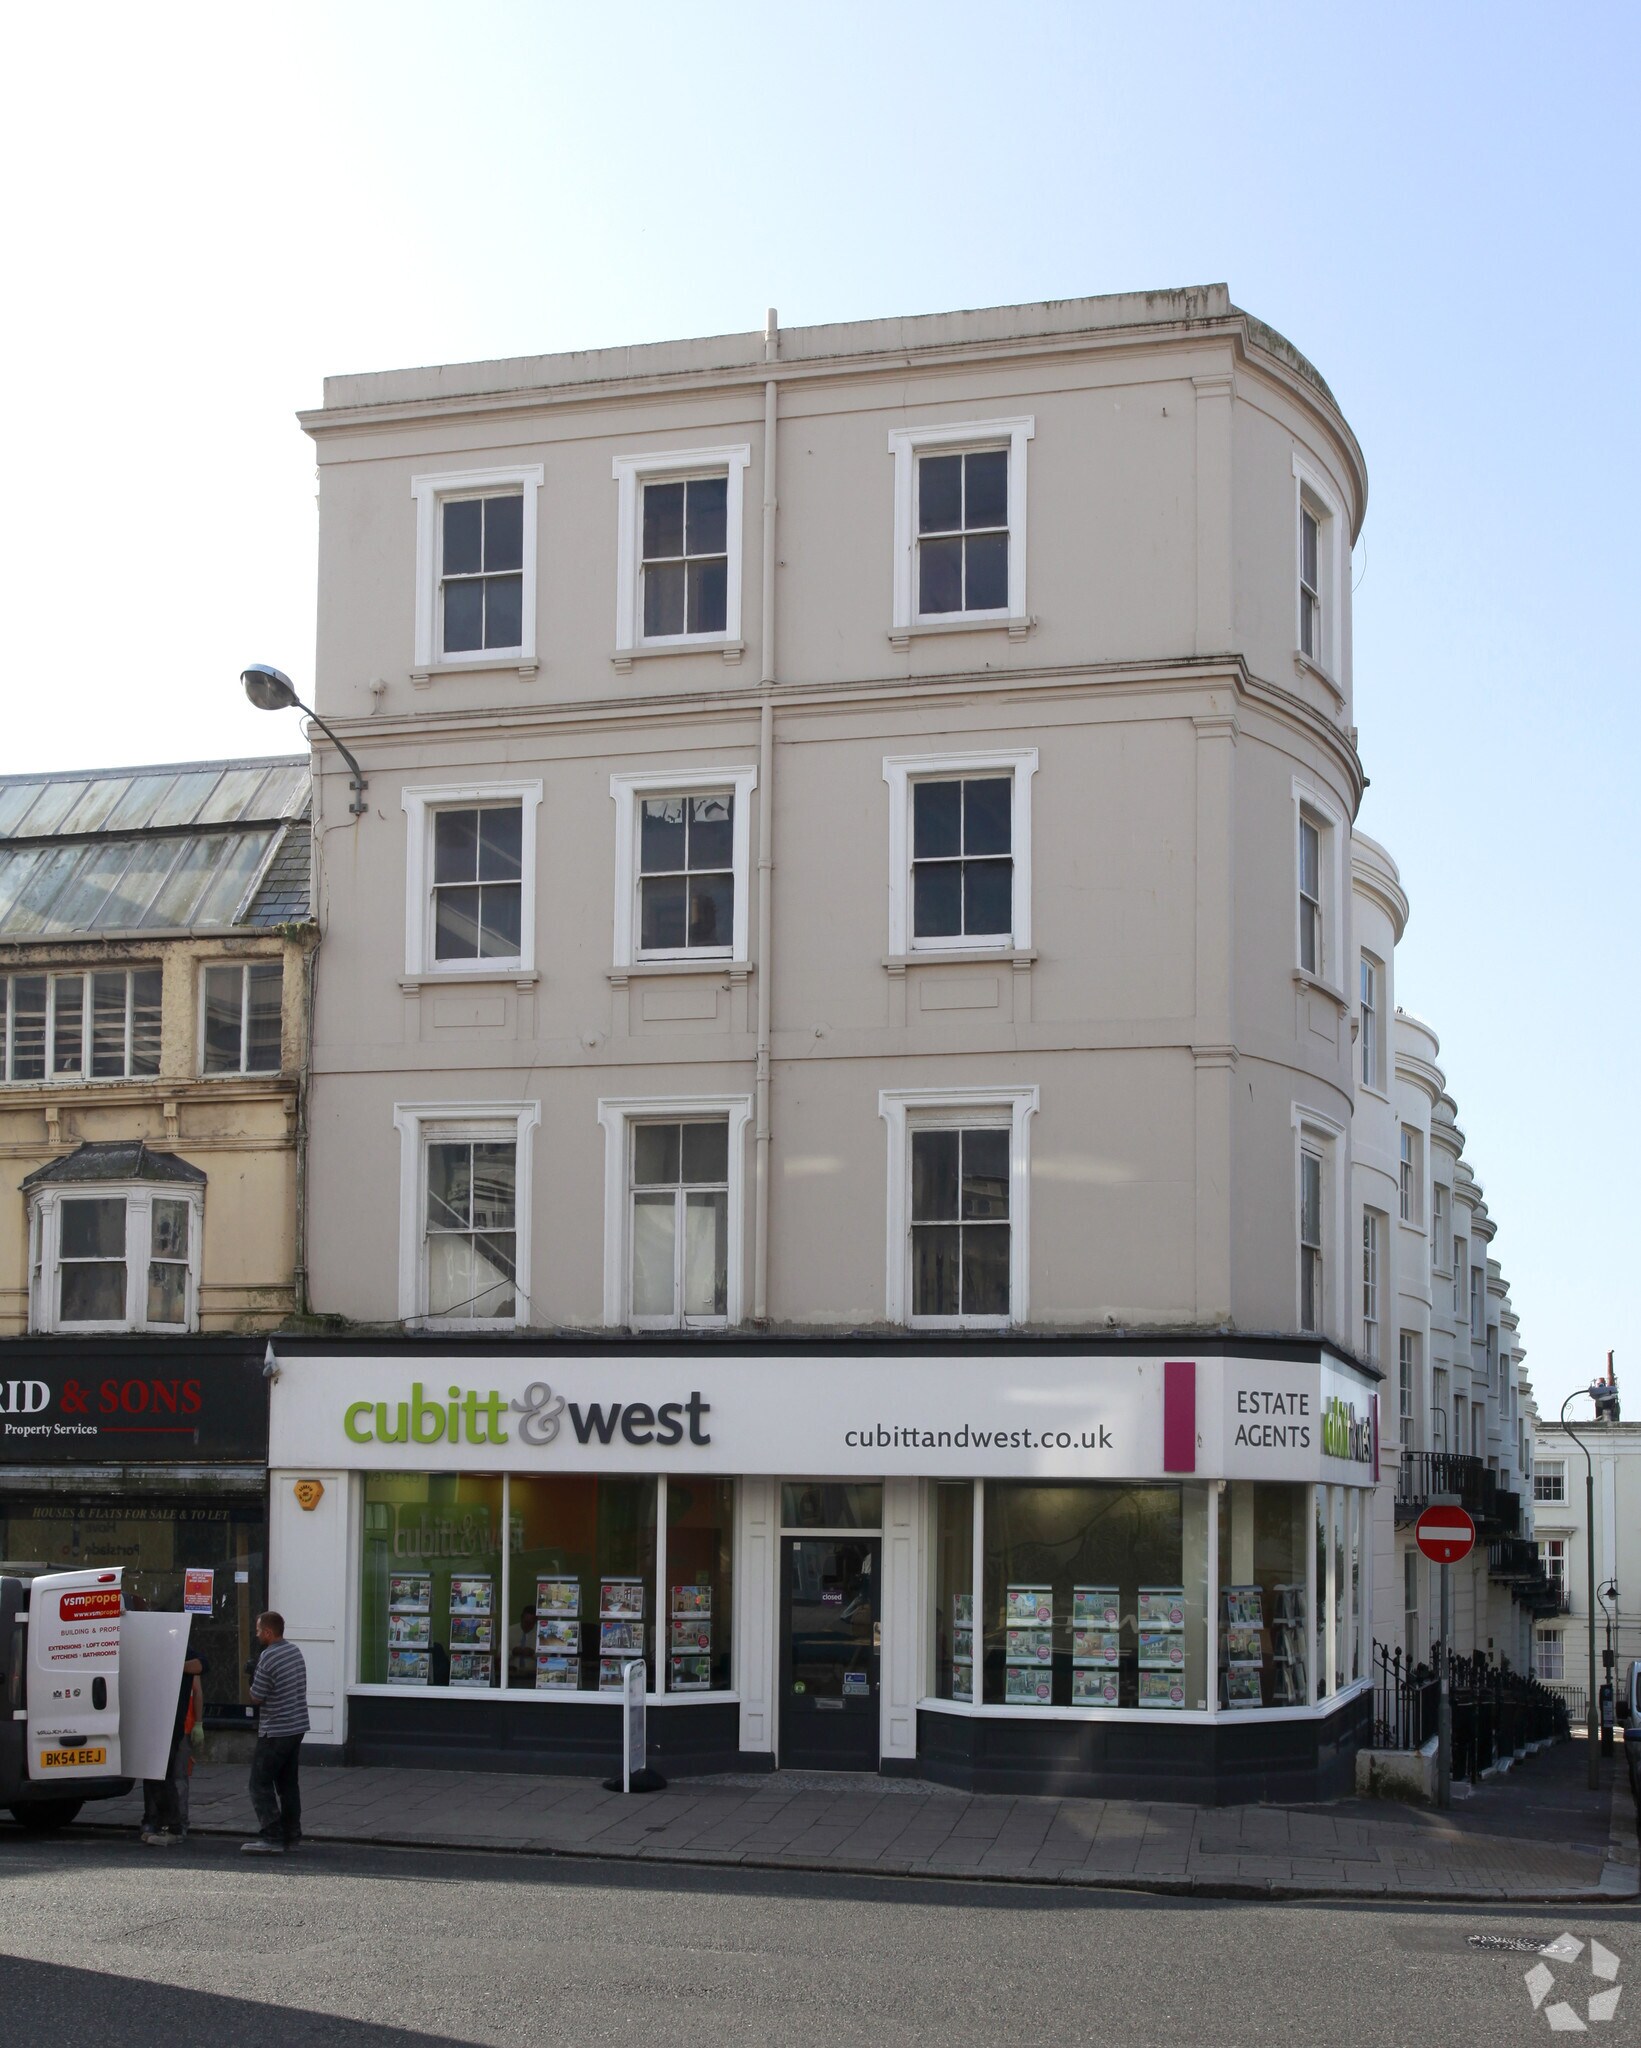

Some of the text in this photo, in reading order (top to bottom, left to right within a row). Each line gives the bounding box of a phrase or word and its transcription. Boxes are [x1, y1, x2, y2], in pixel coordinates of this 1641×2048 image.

[60, 1379, 91, 1413] &
[99, 1379, 203, 1413] SONS
[1237, 1390, 1310, 1416] ESTATE
[4, 1423, 98, 1438] Property Services
[844, 1423, 1114, 1449] cubittandwest.co.uk
[1234, 1424, 1311, 1448] AGENTS
[32, 1507, 230, 1520] HOUSES & FLATS FOR SALE & TO LET
[822, 1593, 842, 1601] closed
[60, 1628, 89, 1637] BUILDING
[48, 1643, 82, 1652] EXTENSIONS
[86, 1641, 100, 1649] LOFT
[51, 1650, 117, 1661] KITCHENS BATHROOMS
[46, 1750, 101, 1766] BK54 EEJ
